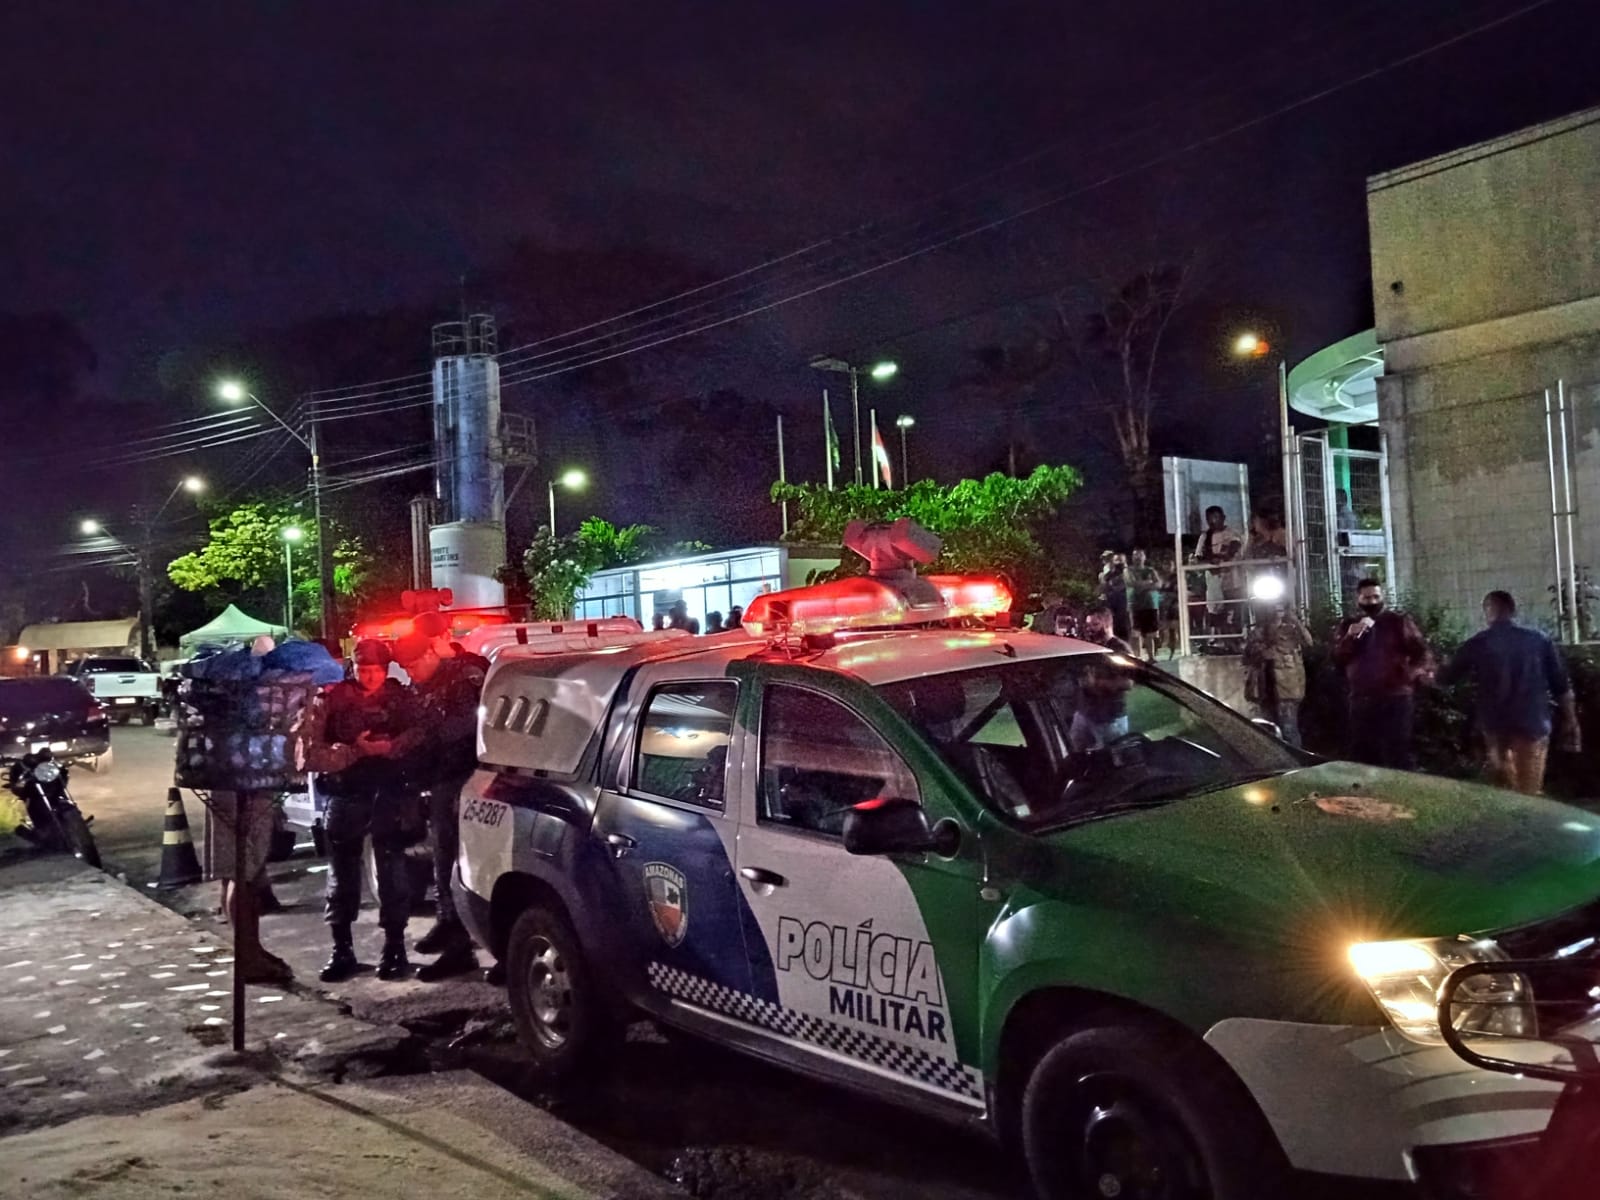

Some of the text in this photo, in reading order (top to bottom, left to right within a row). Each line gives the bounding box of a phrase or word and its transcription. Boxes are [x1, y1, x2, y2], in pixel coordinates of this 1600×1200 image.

[463, 799, 507, 828] 25-6287
[645, 865, 684, 889] AMAZONAS
[777, 917, 943, 1007] POLÍCIA
[829, 985, 947, 1043] MILITAR
